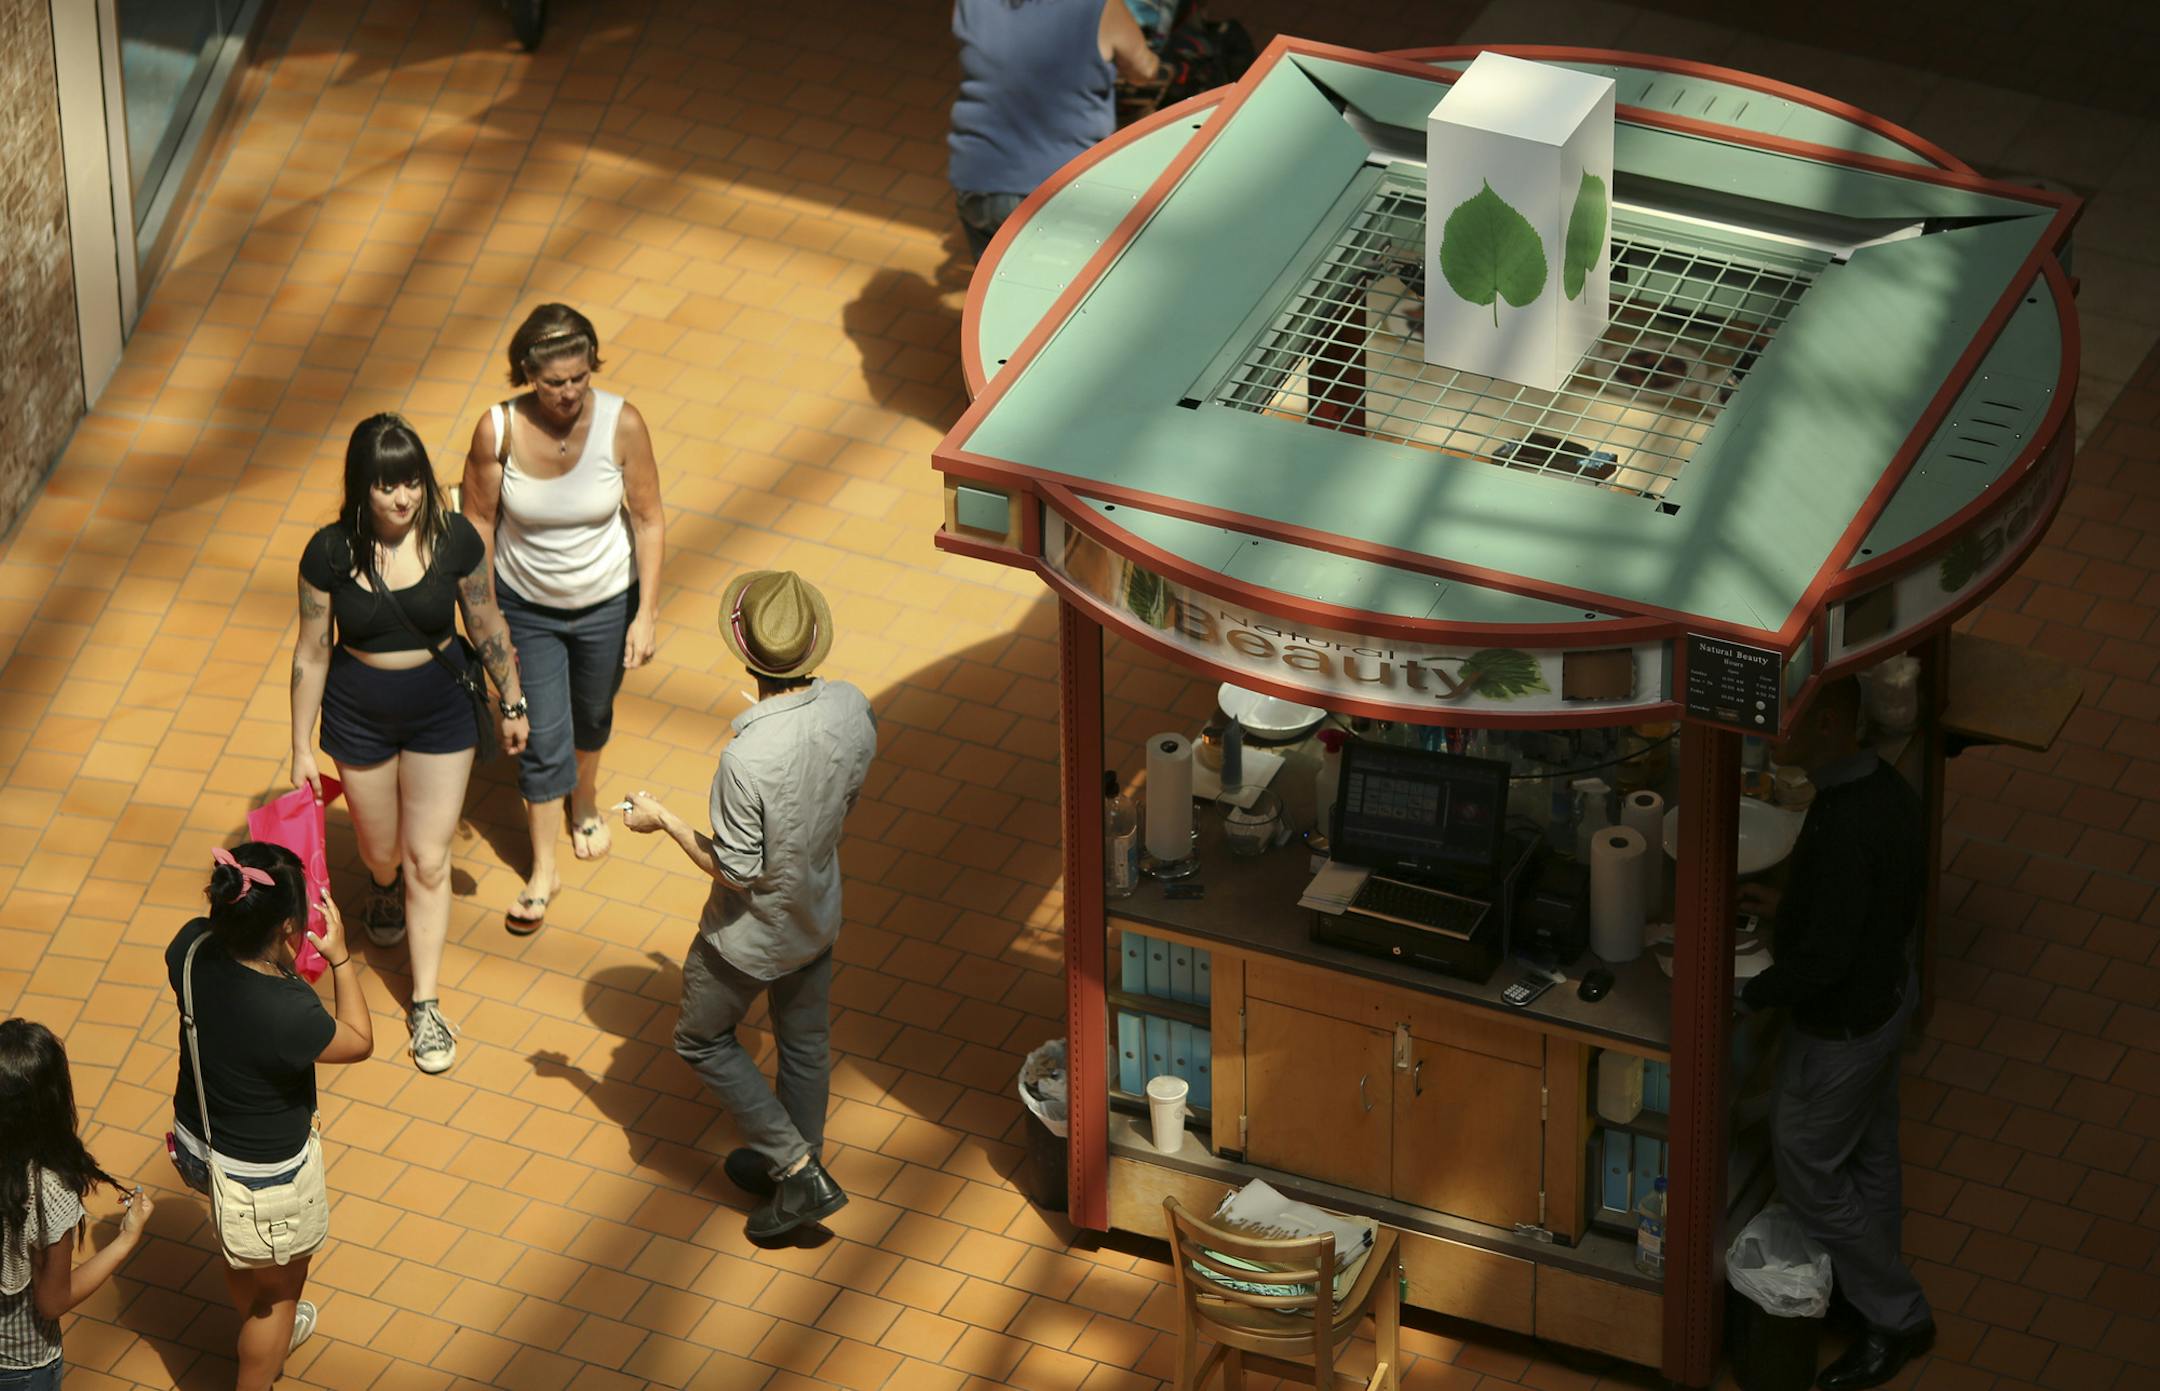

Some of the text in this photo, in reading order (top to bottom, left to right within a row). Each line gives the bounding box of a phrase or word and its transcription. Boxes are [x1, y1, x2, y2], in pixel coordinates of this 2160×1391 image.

[1174, 597, 1482, 699] Beauty
[1220, 610, 1394, 660] Natural
[1699, 643, 1769, 666] Natural Beauty
